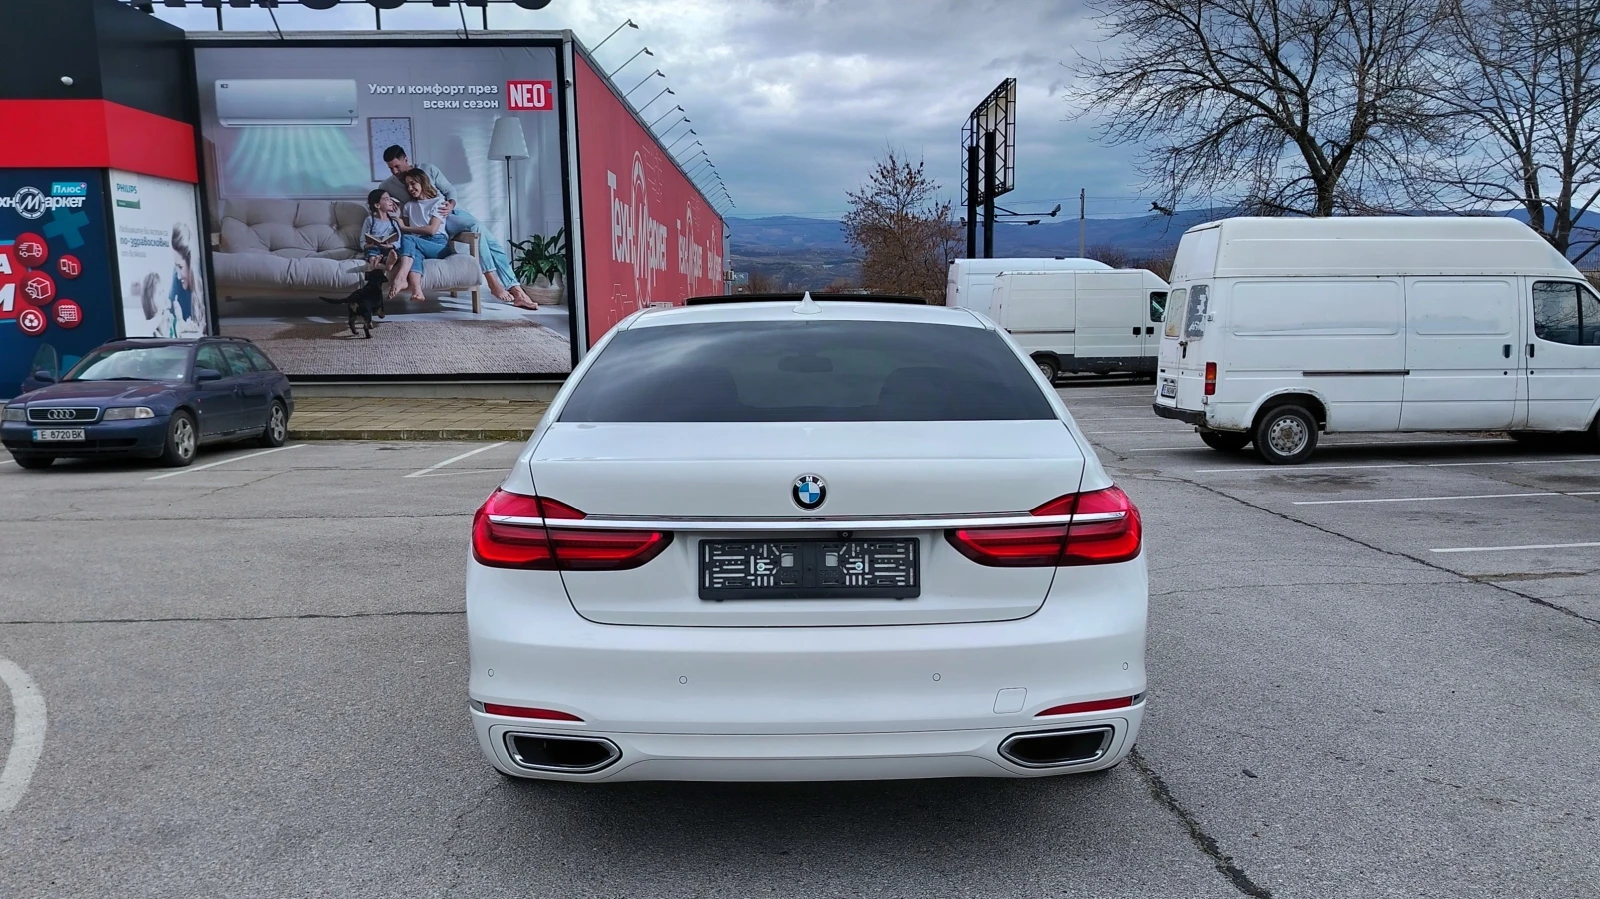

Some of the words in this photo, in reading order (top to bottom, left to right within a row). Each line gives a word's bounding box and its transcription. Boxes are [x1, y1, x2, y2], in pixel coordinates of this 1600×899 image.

[368, 83, 395, 95] Уют
[397, 85, 406, 94] и
[408, 83, 465, 96] комфорт
[468, 85, 499, 95] през
[509, 84, 546, 108] NEO
[423, 100, 460, 109] всеки
[462, 100, 499, 109] сезон
[53, 184, 82, 194] Плюс
[116, 183, 138, 194] PHILIPS
[41, 430, 47, 440] E
[50, 430, 70, 439] 8720
[71, 430, 83, 439] BK
[795, 476, 824, 487] BMW
